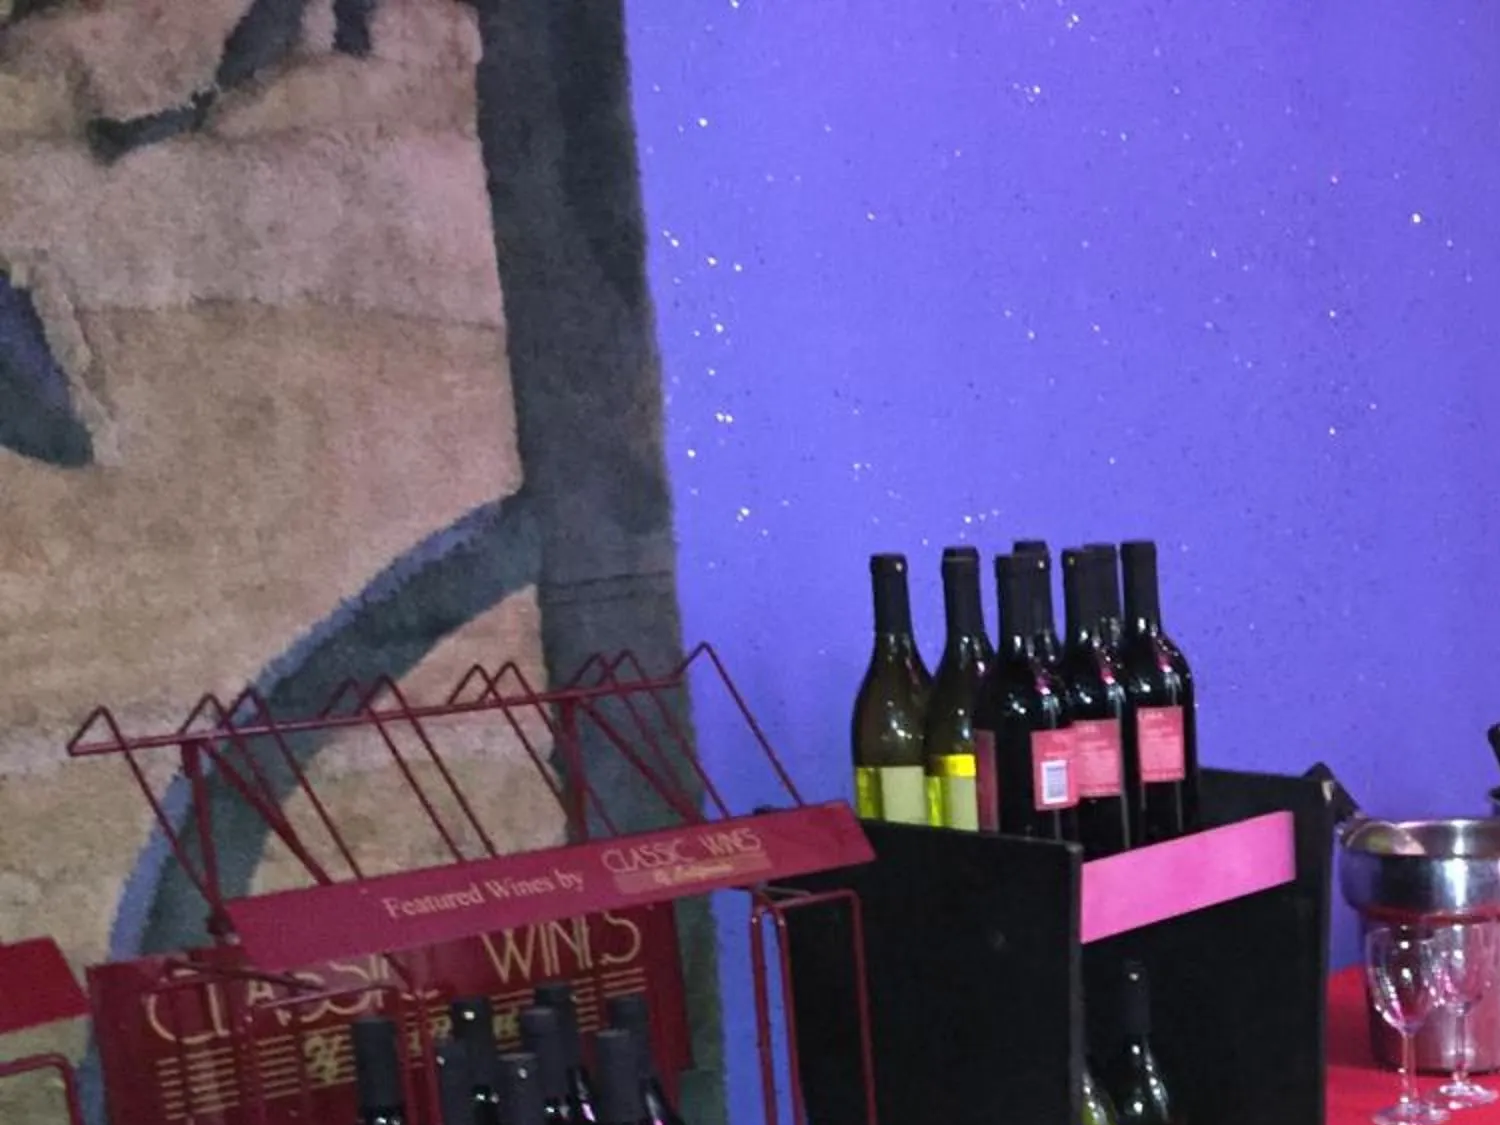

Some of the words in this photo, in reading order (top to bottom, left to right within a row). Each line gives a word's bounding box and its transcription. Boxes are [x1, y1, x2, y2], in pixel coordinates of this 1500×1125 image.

[382, 882, 486, 919] Featured
[483, 878, 557, 898] Wines
[554, 868, 586, 893] by
[601, 838, 700, 873] CLASSIC
[698, 827, 762, 856] WINES
[146, 953, 441, 1045] CLASSI
